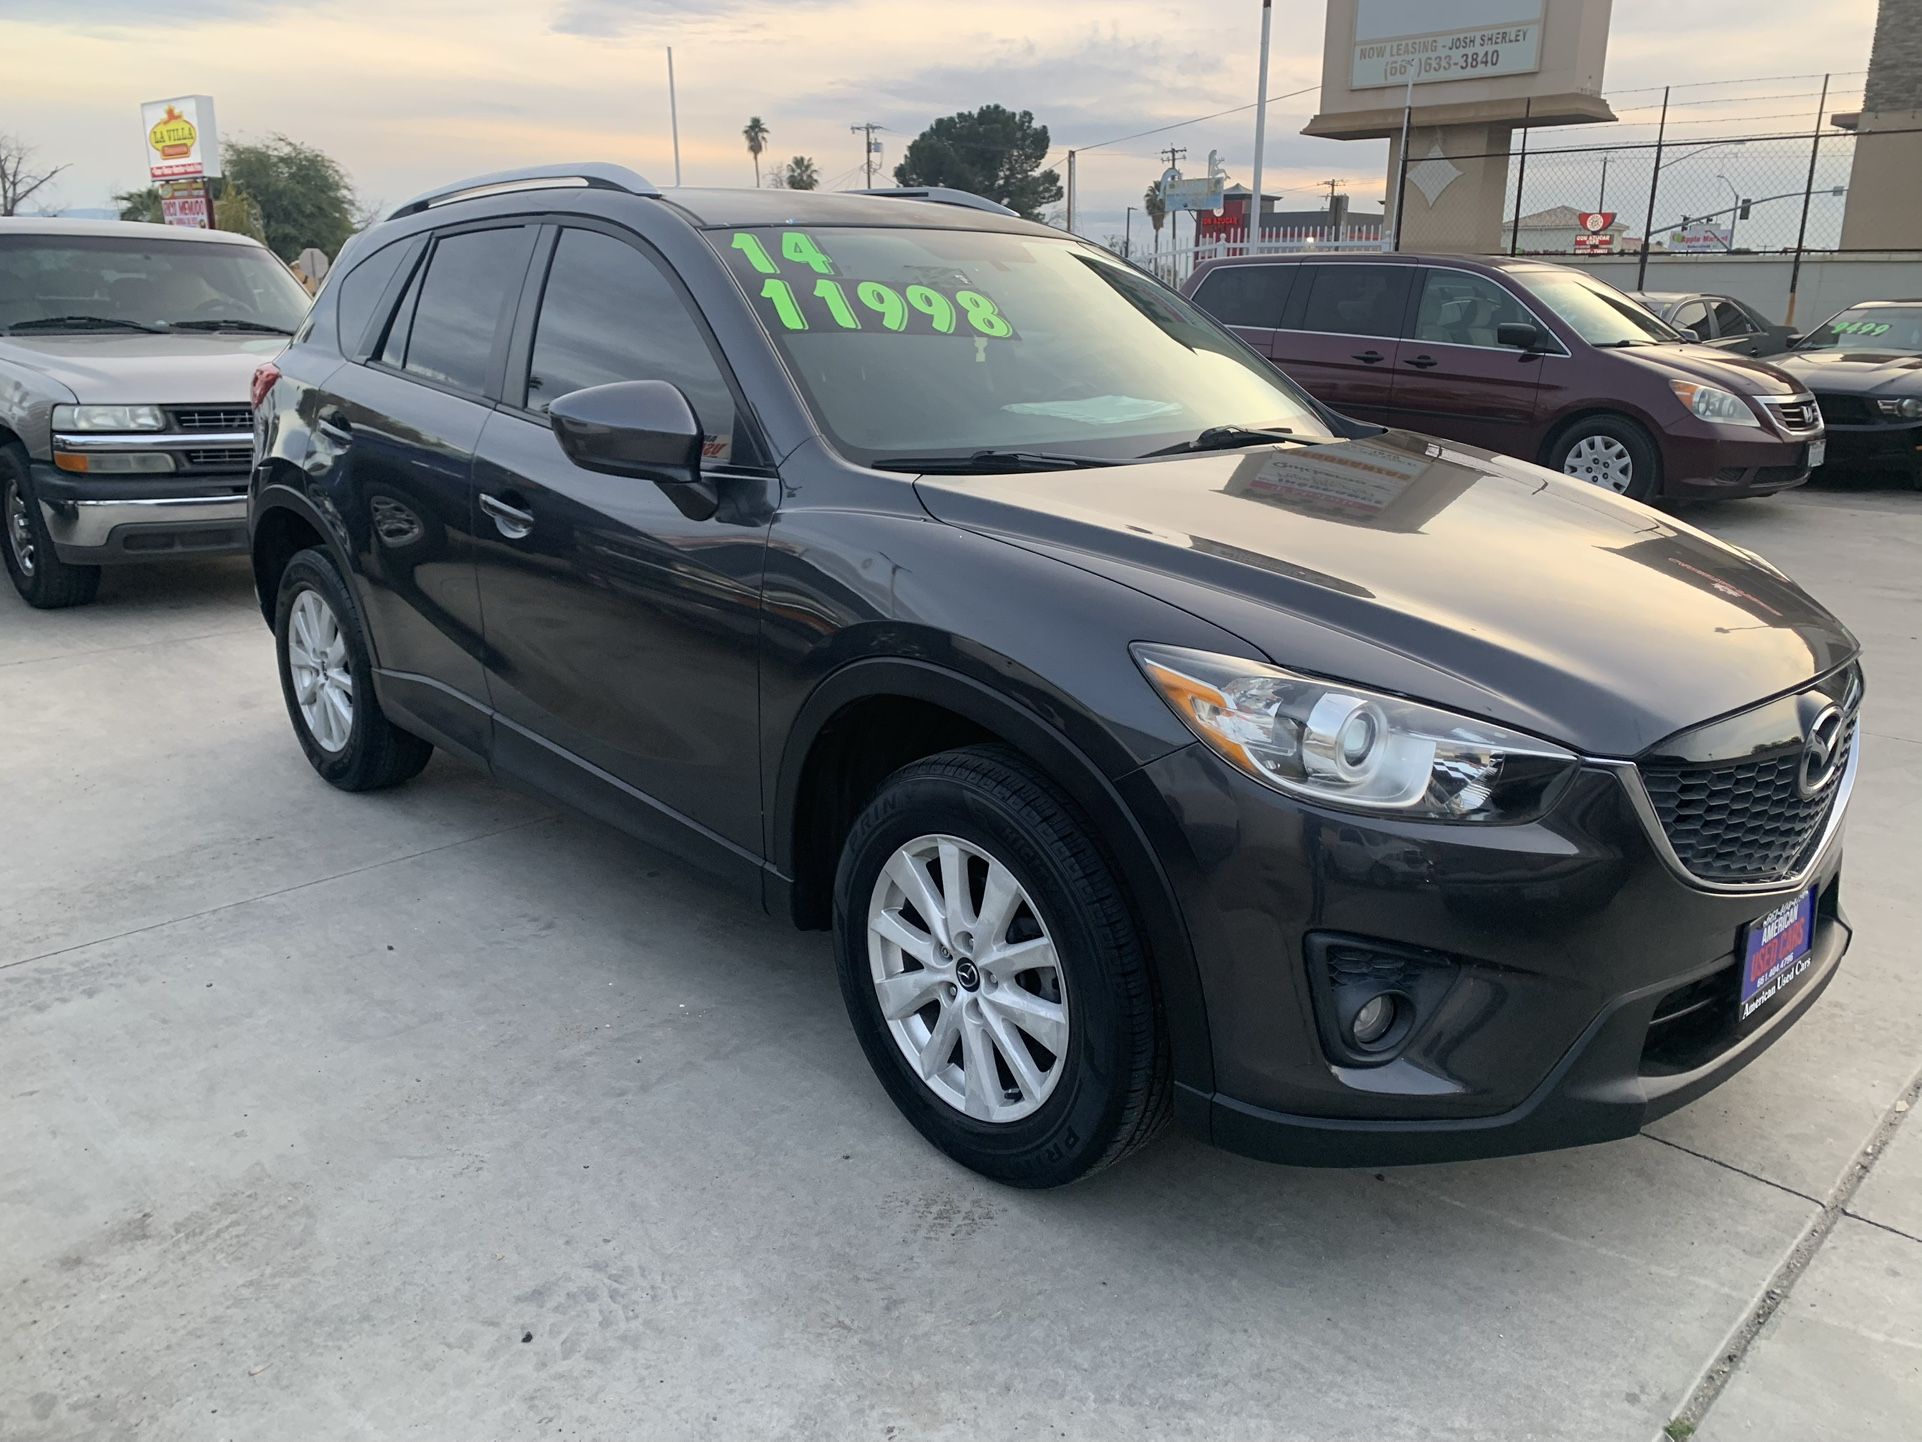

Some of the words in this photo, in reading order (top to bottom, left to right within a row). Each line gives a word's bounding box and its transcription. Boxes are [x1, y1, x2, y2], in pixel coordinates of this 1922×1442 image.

[1359, 45, 1387, 60] NOW
[1389, 39, 1438, 58] LEASING
[1479, 28, 1530, 48] SHERLEY
[1383, 49, 1500, 81] (66)633-3840
[152, 130, 166, 144] LA
[166, 127, 194, 142] VILLA
[730, 231, 835, 275] 14
[760, 278, 1014, 338] 11998
[1831, 321, 1891, 336] 9499
[1761, 903, 1800, 946] AMERICAN
[1750, 938, 1779, 982] USED
[1777, 917, 1806, 959] CARS
[1742, 984, 1776, 1020] American
[1776, 967, 1795, 990] Used
[1795, 957, 1812, 976] Cars
